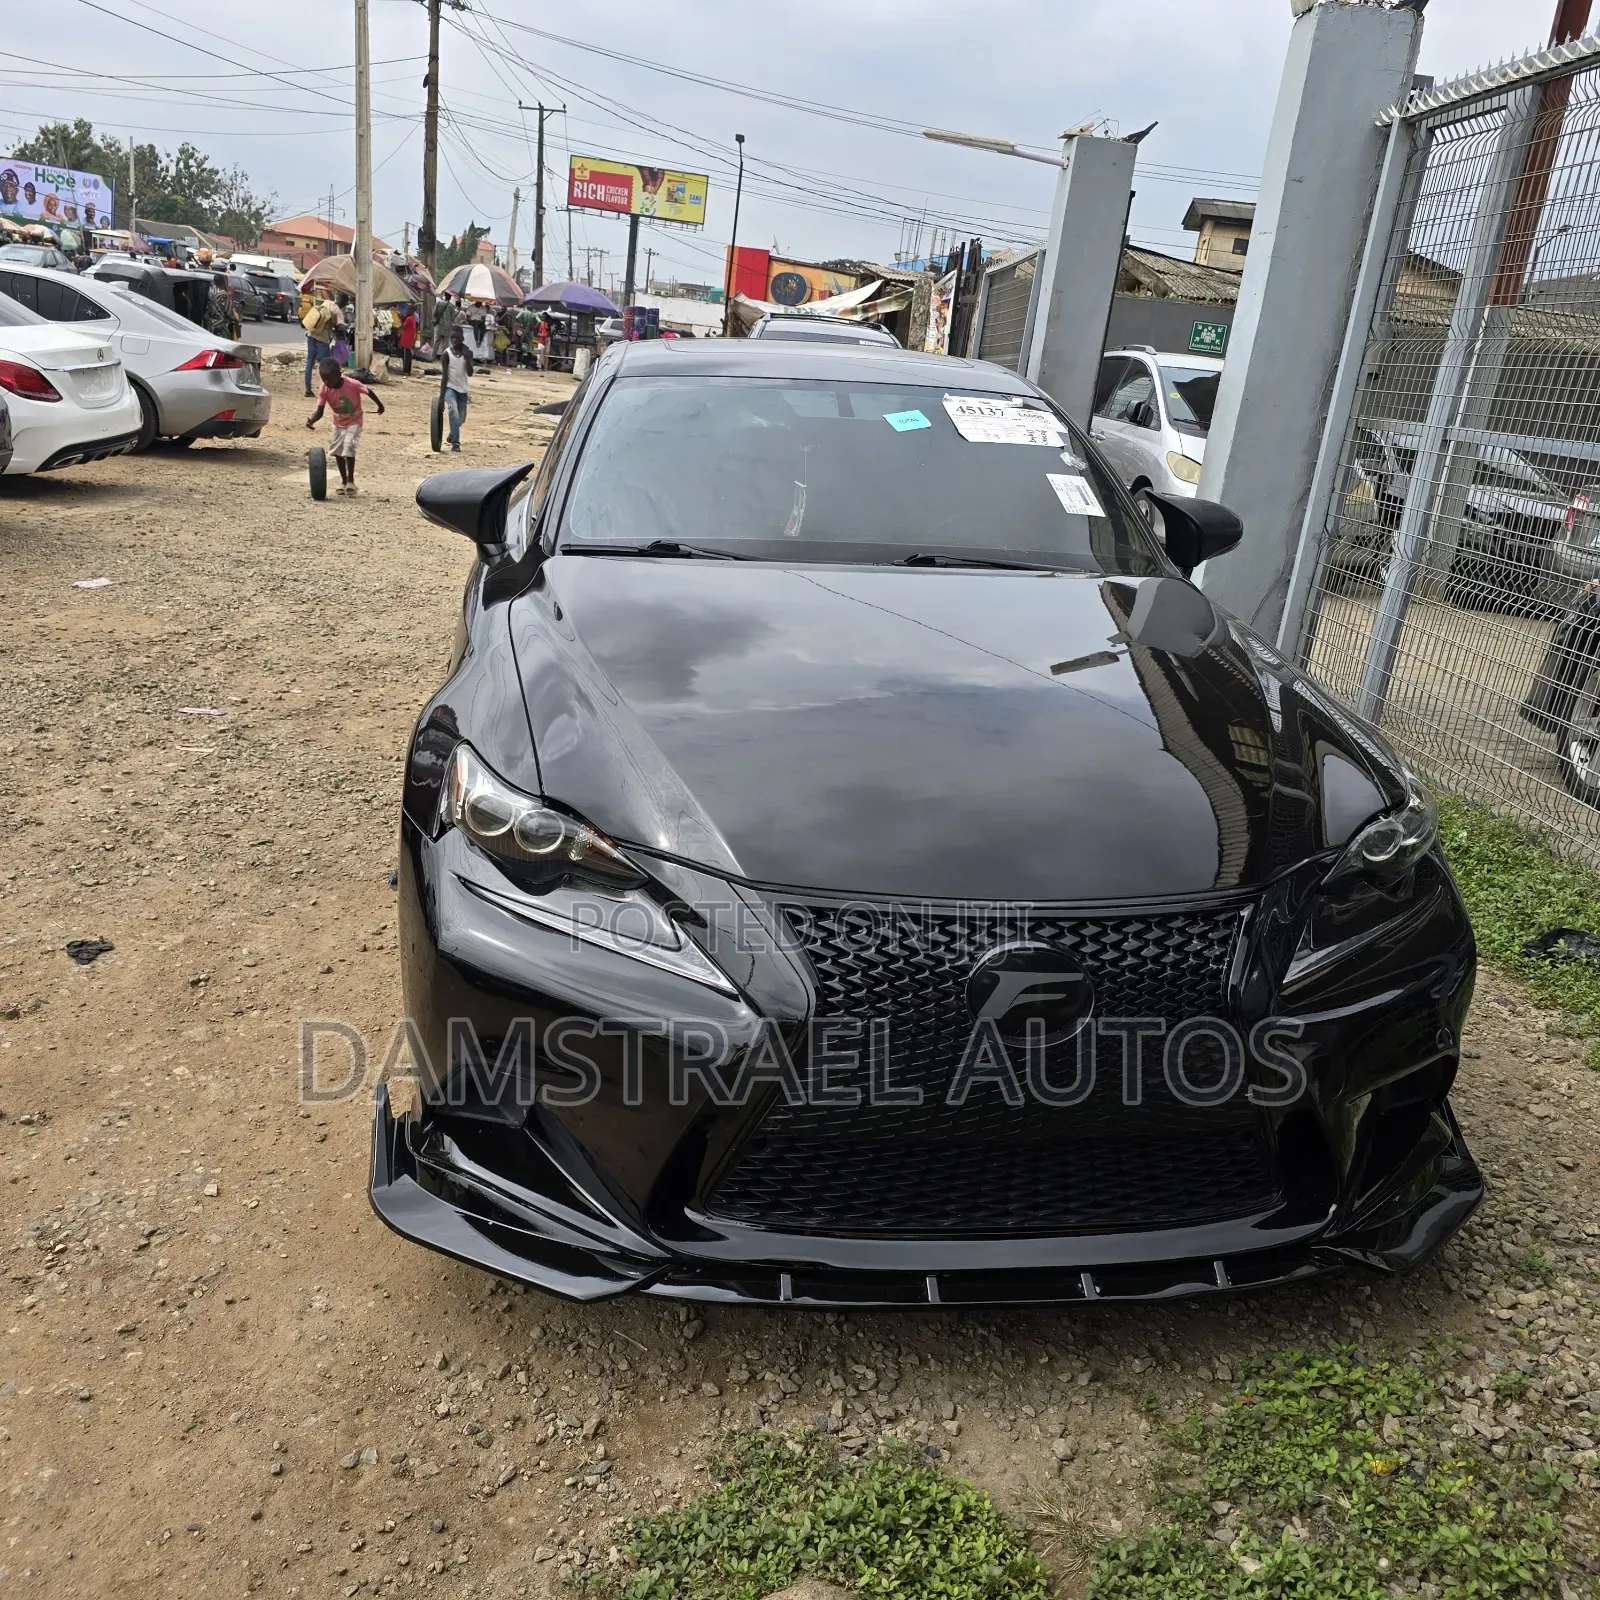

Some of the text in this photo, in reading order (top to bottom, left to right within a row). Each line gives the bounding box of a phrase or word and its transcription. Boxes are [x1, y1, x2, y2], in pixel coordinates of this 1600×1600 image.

[34, 167, 76, 193] Hope
[573, 181, 606, 202] RICH
[606, 185, 629, 197] CHICKEN
[605, 195, 628, 206] FLAVOUR
[956, 405, 1004, 417] 45137
